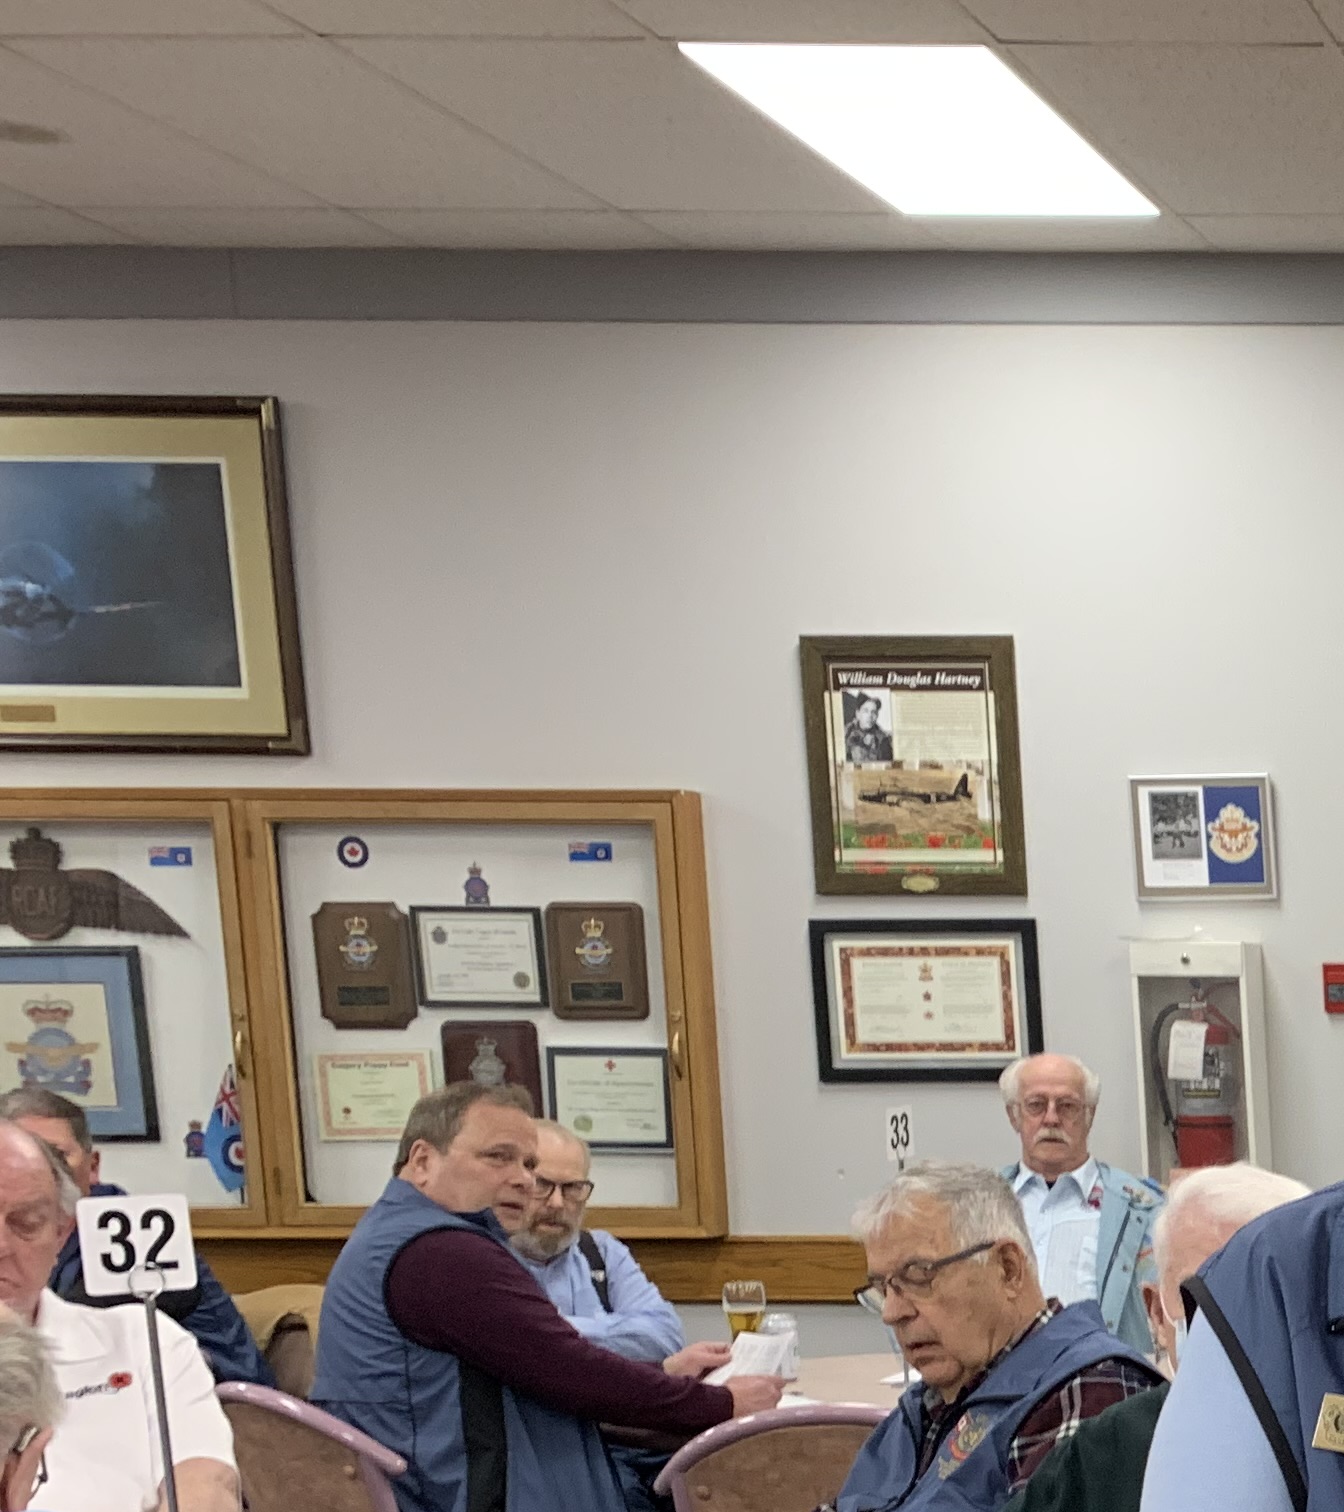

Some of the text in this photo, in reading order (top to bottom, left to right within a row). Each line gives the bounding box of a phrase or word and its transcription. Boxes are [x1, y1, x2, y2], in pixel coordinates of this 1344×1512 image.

[837, 670, 981, 689] William Douglas Hartney
[890, 1111, 910, 1150] 33
[97, 1208, 179, 1274] 32
